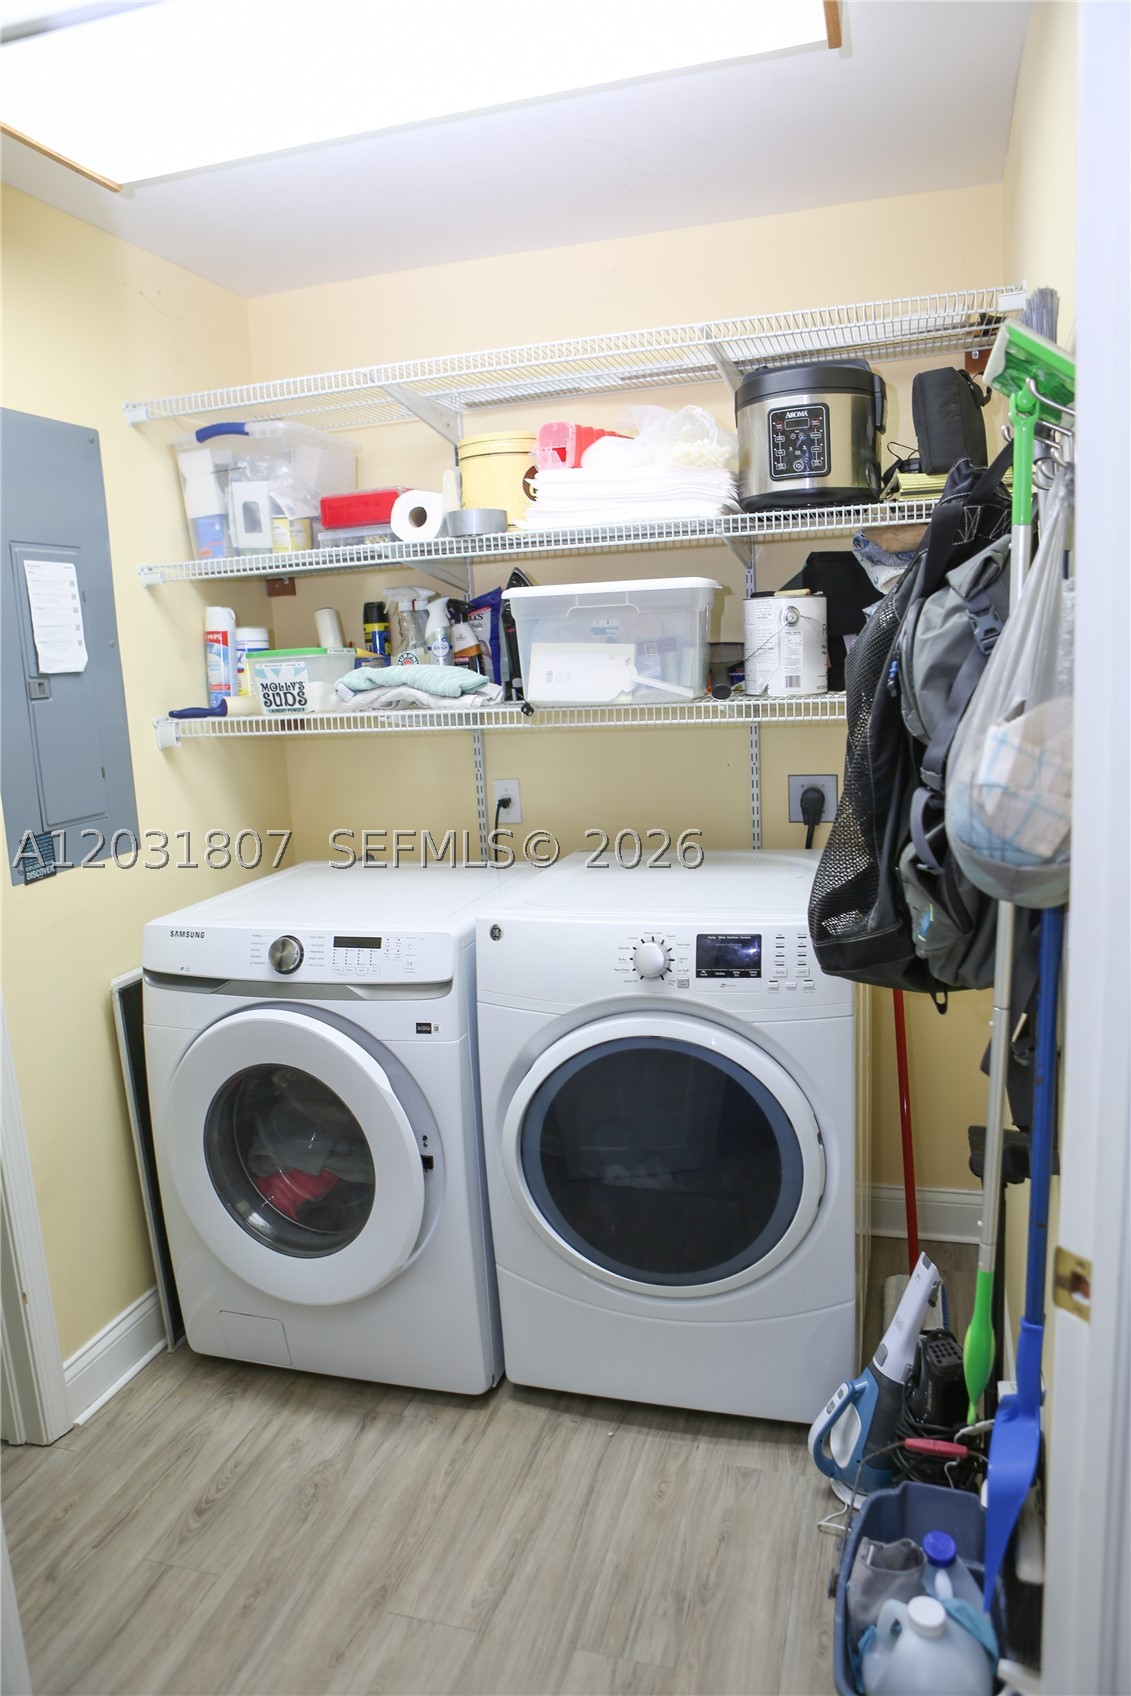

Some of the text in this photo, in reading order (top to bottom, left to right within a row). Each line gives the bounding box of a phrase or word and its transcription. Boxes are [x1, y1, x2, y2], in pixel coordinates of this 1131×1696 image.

[785, 410, 808, 419] AROMA
[260, 681, 305, 693] MOLLY'S
[262, 690, 308, 708] SUDS
[26, 865, 56, 881] DISCOVER
[169, 930, 205, 939] SAMSUNG
